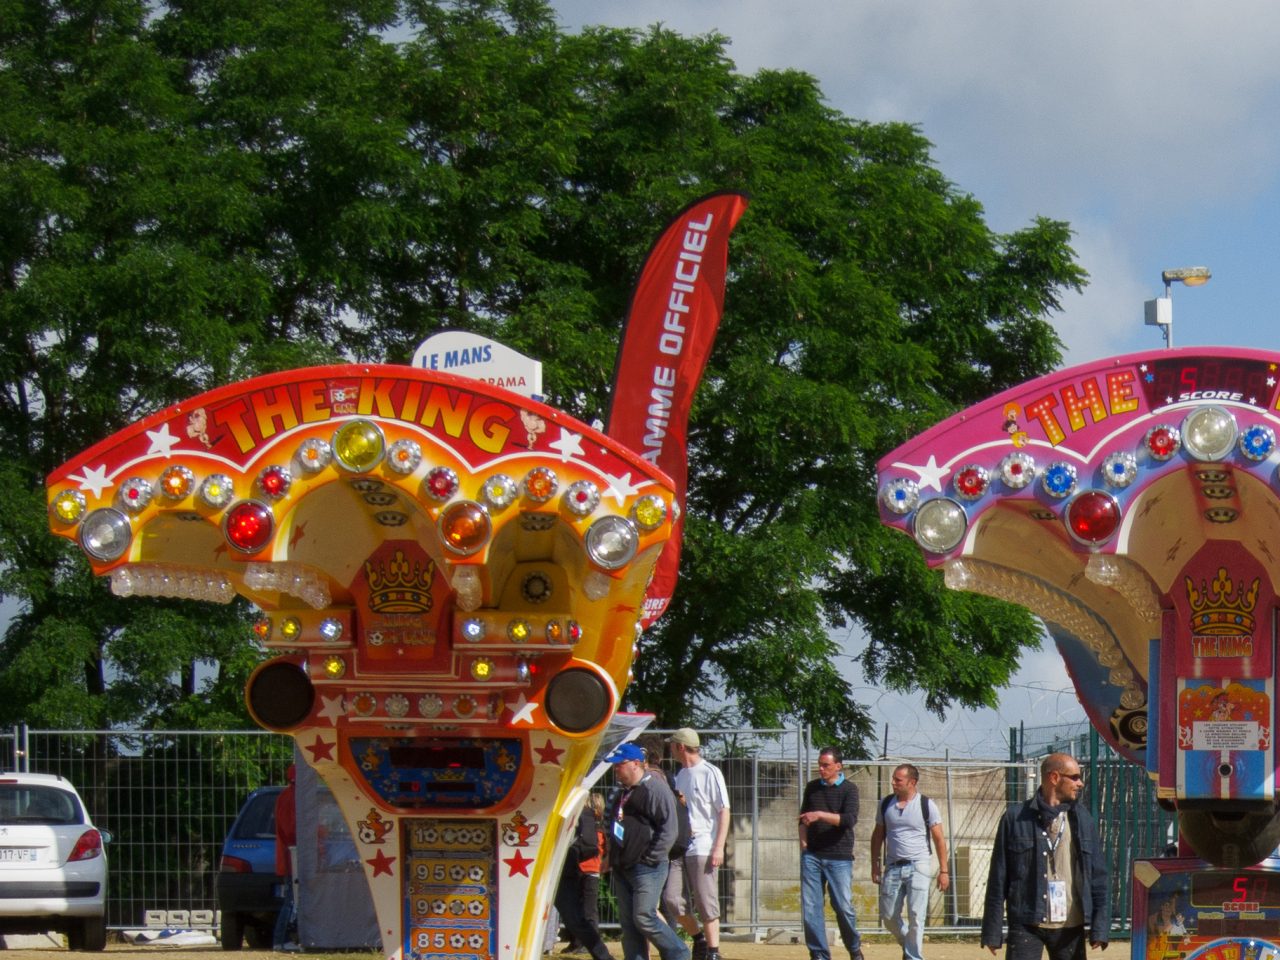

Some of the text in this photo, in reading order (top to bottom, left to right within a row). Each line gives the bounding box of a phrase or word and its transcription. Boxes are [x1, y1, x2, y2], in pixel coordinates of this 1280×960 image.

[659, 213, 714, 356] OFFICIEL
[443, 344, 493, 369] MANS
[214, 375, 516, 454] THE KING
[1025, 369, 1139, 447] THE
[1177, 390, 1244, 402] SCORE
[1191, 634, 1253, 658] THE KING
